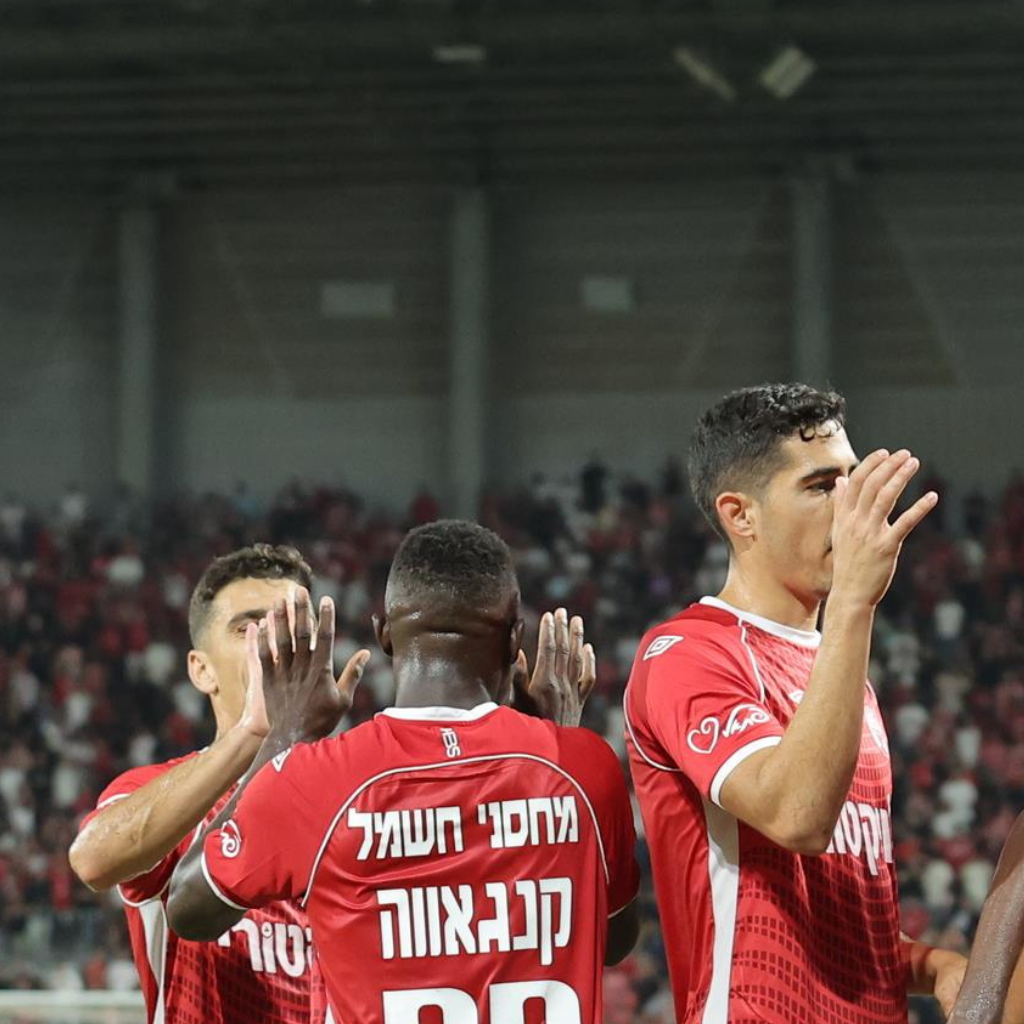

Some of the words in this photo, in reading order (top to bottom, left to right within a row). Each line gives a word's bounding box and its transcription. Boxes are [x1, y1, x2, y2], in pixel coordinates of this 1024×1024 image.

[348, 806, 464, 860] חשמל
[477, 796, 579, 848] מחסני
[376, 877, 573, 966] קנגאווה
